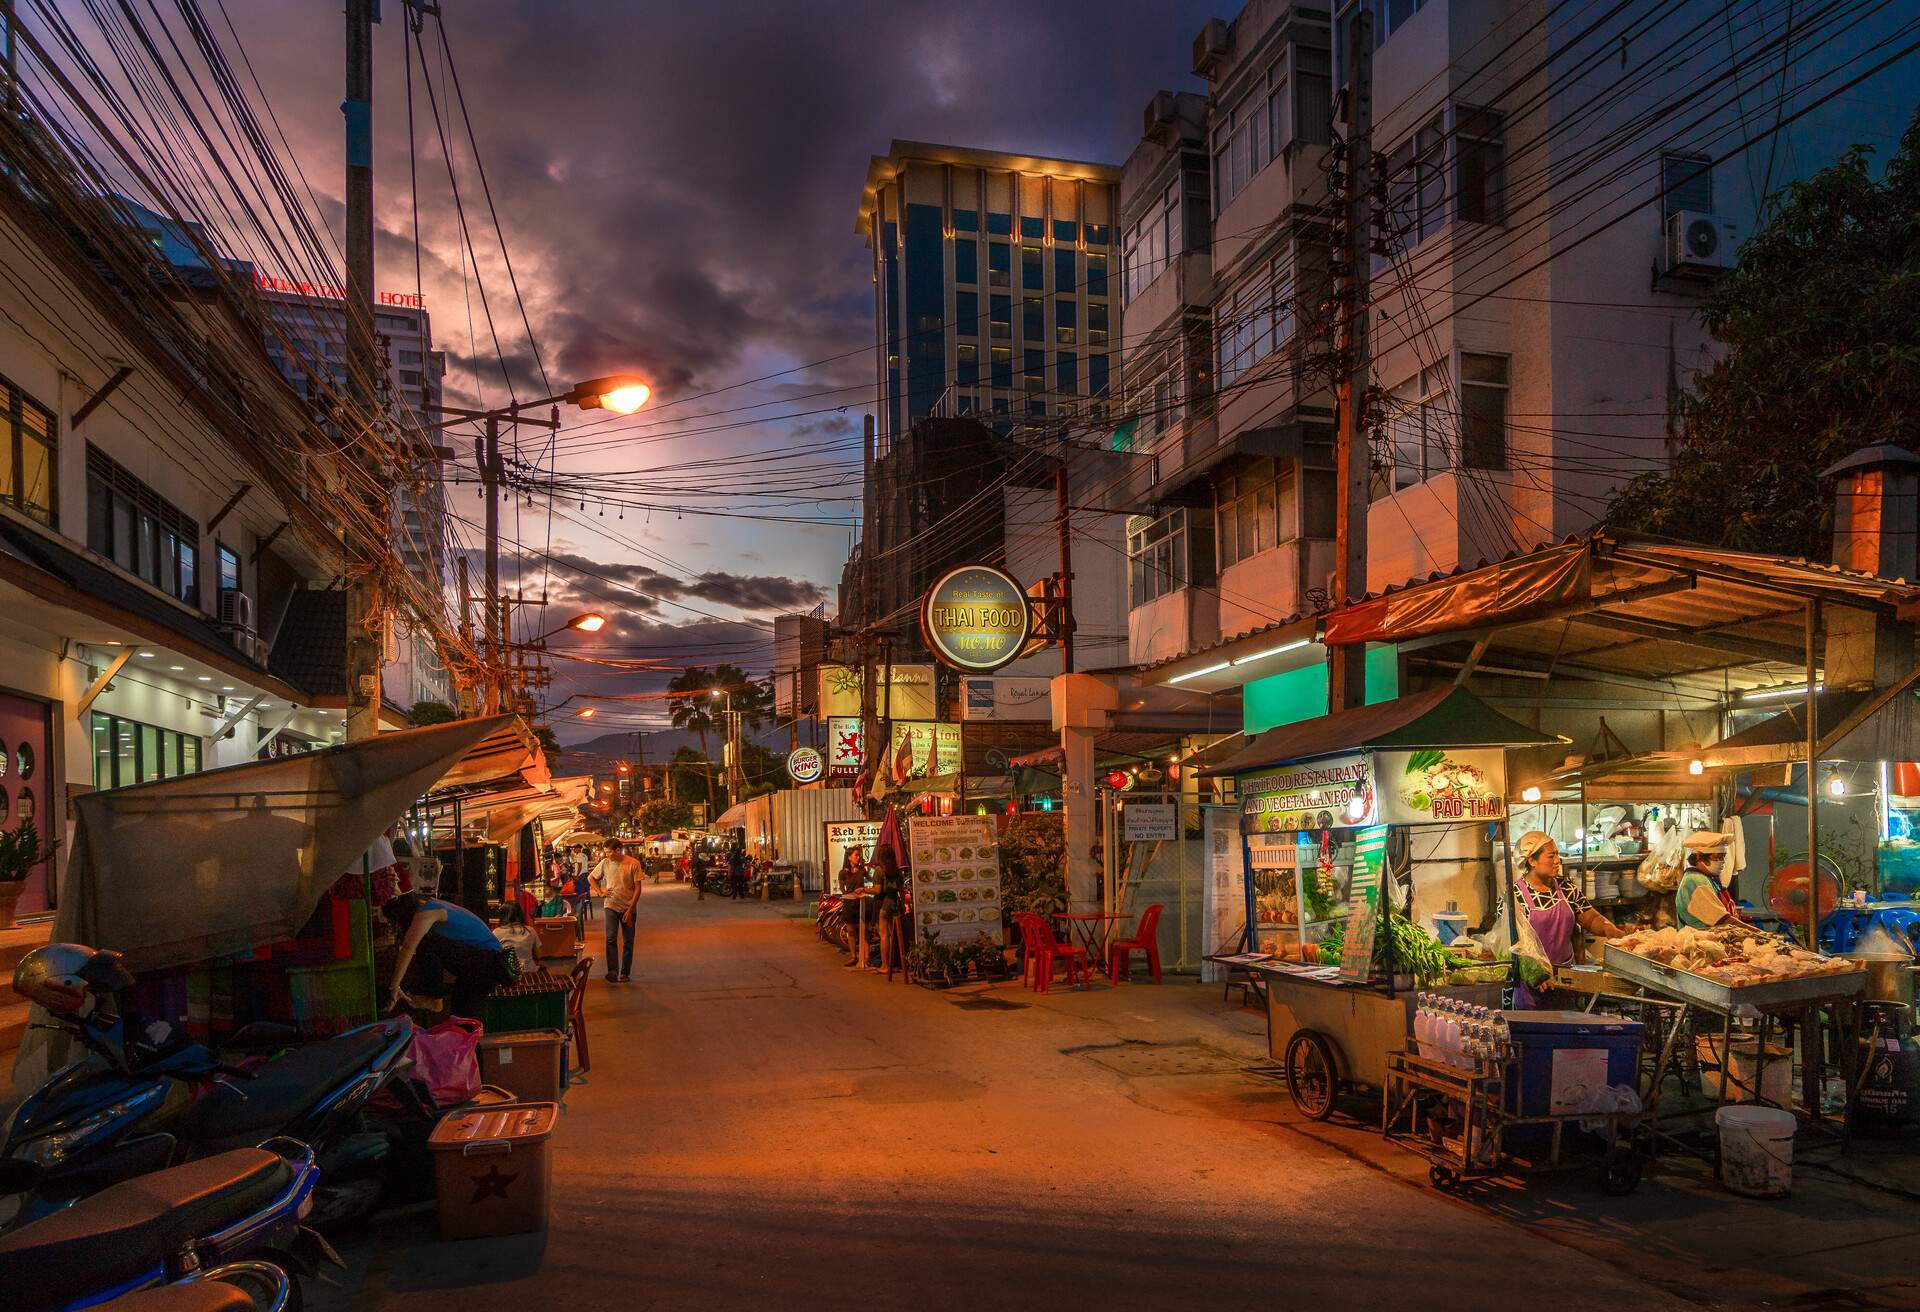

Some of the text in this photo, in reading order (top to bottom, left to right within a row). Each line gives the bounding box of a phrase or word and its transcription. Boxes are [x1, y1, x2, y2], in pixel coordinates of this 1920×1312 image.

[380, 291, 426, 309] HOTEL
[952, 590, 970, 598] Real
[973, 590, 993, 598] Taste
[936, 608, 1022, 627] THAI FOOD
[794, 756, 816, 765] BURGER
[794, 761, 817, 772] KING
[831, 766, 859, 774] FULLE
[1242, 763, 1369, 794] THAI FOOD RESTAURANT
[1245, 798, 1266, 814] AND
[1266, 792, 1334, 813] VEGETARIAN
[1433, 798, 1504, 818] PAD THAI
[913, 819, 954, 828] WELCOME
[831, 827, 854, 836] Red
